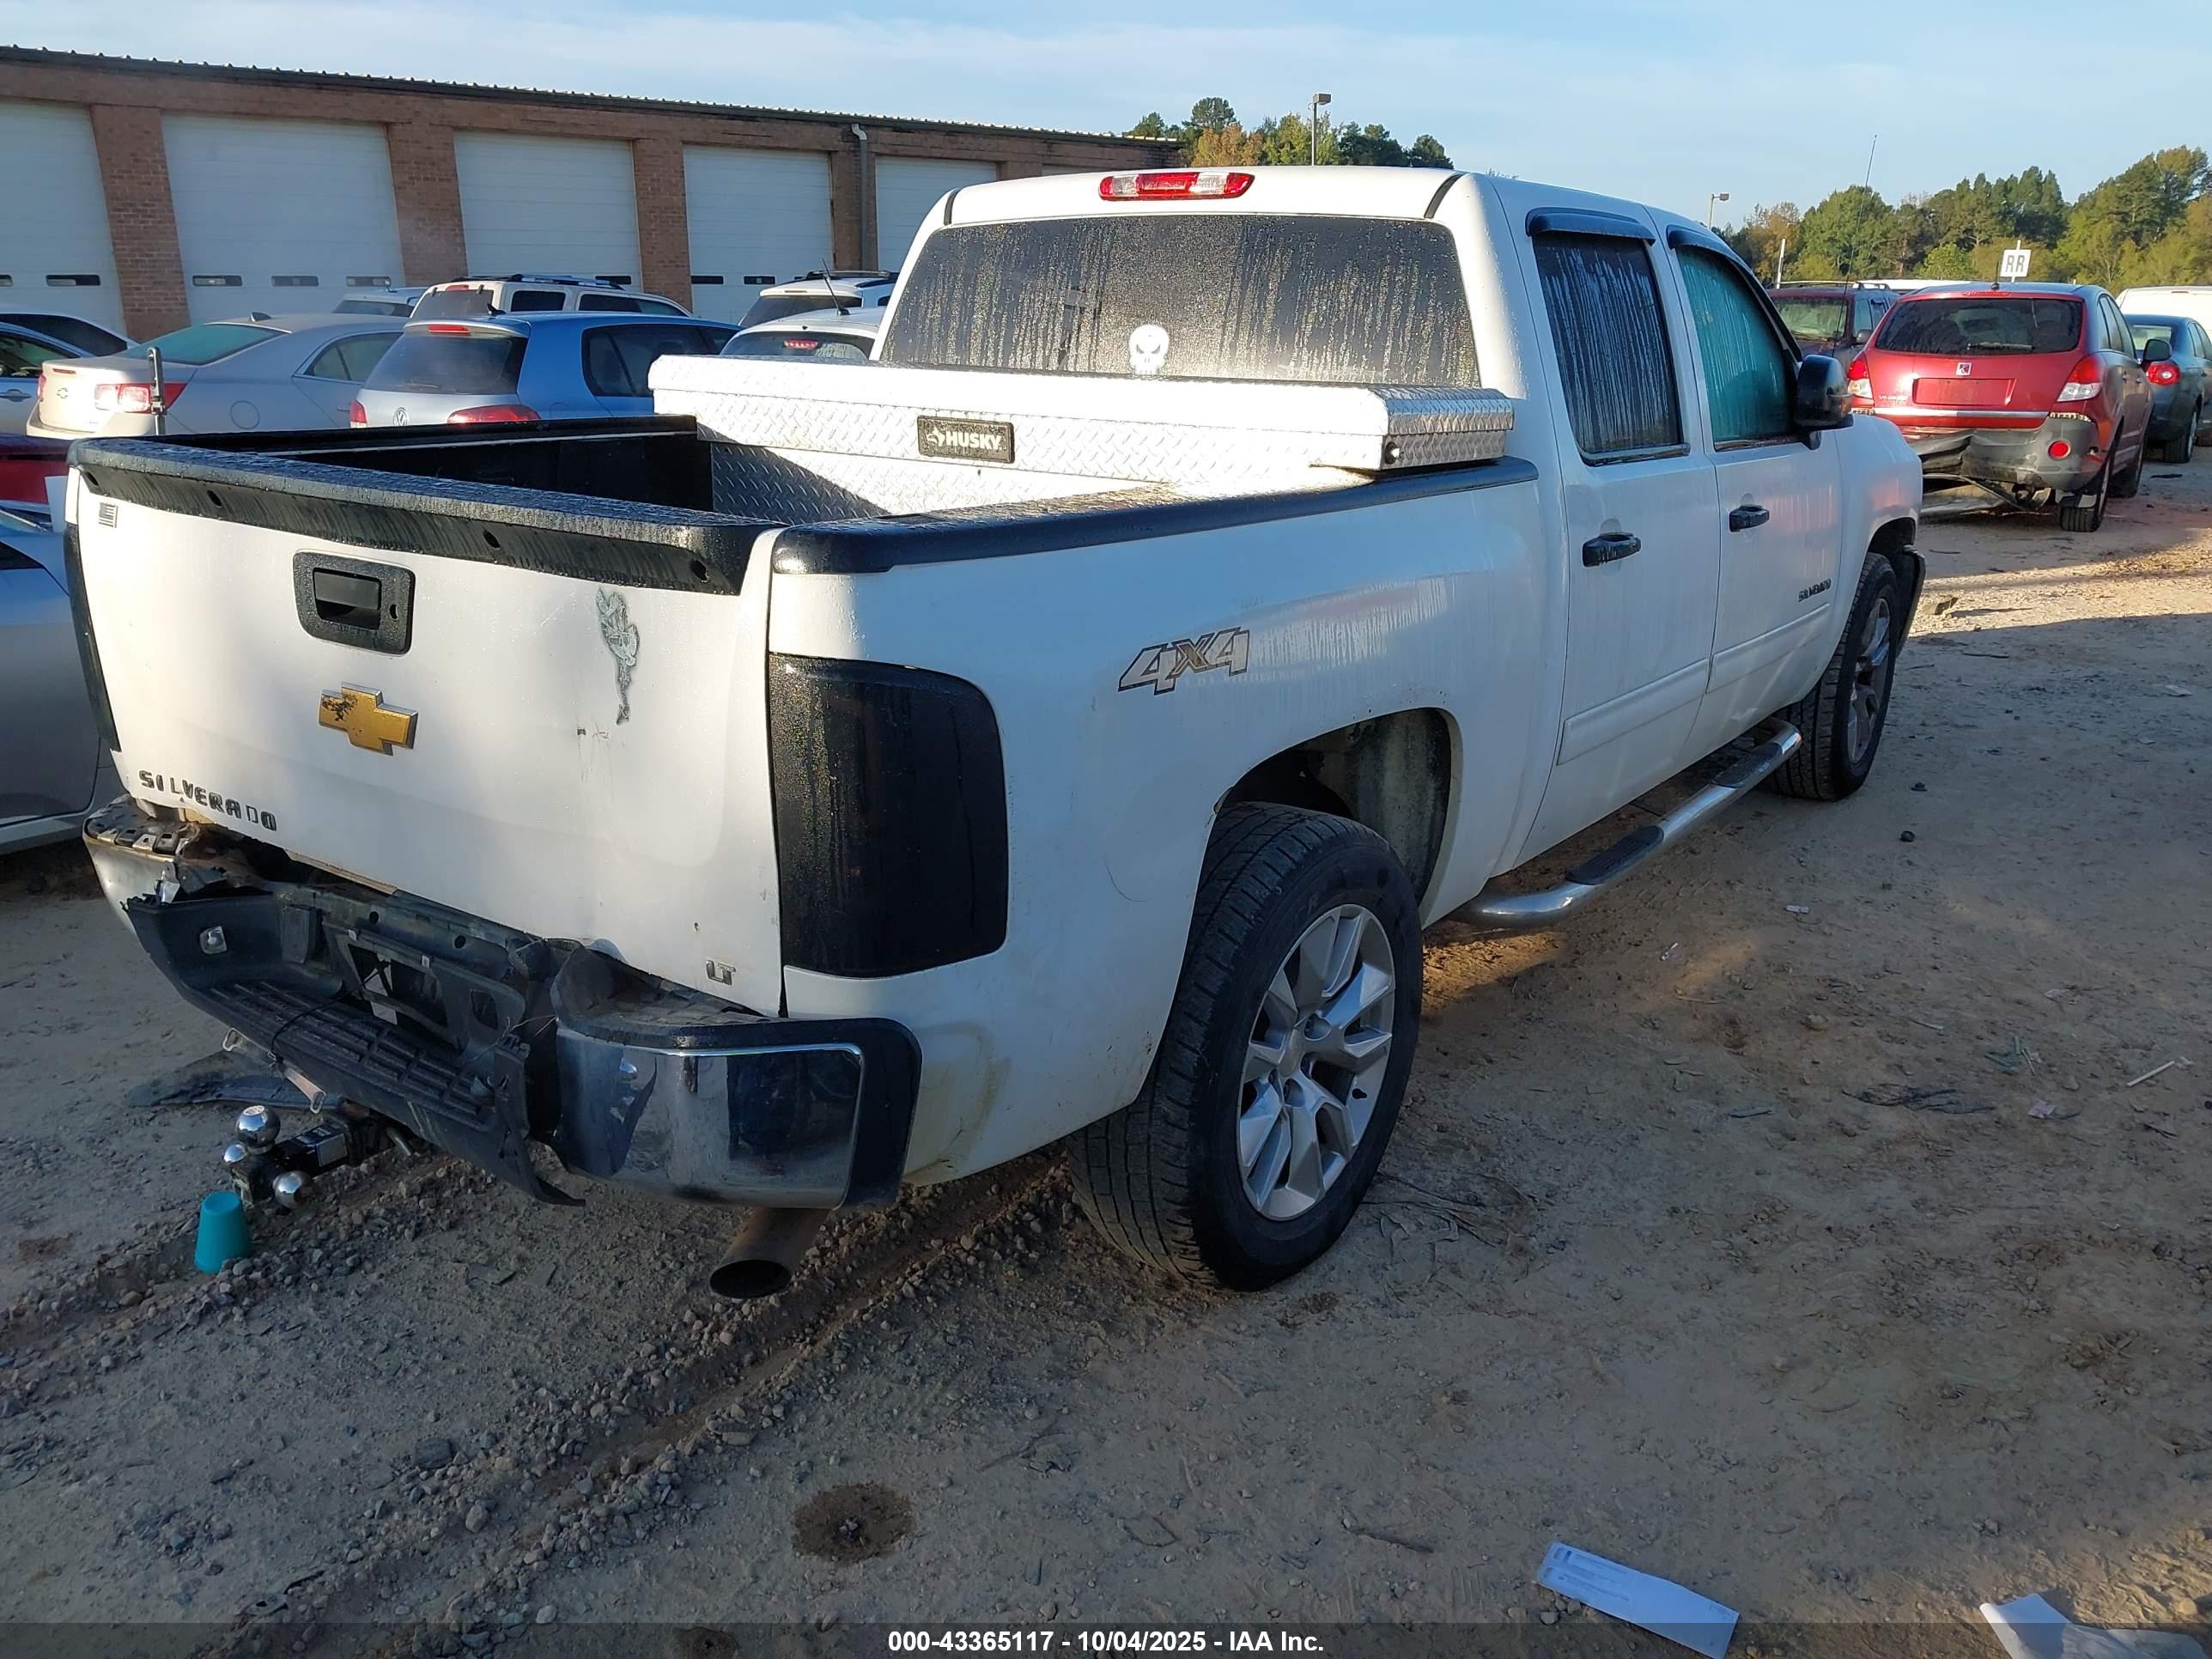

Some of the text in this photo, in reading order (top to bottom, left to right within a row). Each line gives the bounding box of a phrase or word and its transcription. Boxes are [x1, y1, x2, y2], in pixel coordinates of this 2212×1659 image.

[945, 429, 1002, 450] HUSKY
[138, 770, 277, 832] SILVERADO
[706, 959, 737, 986] LT
